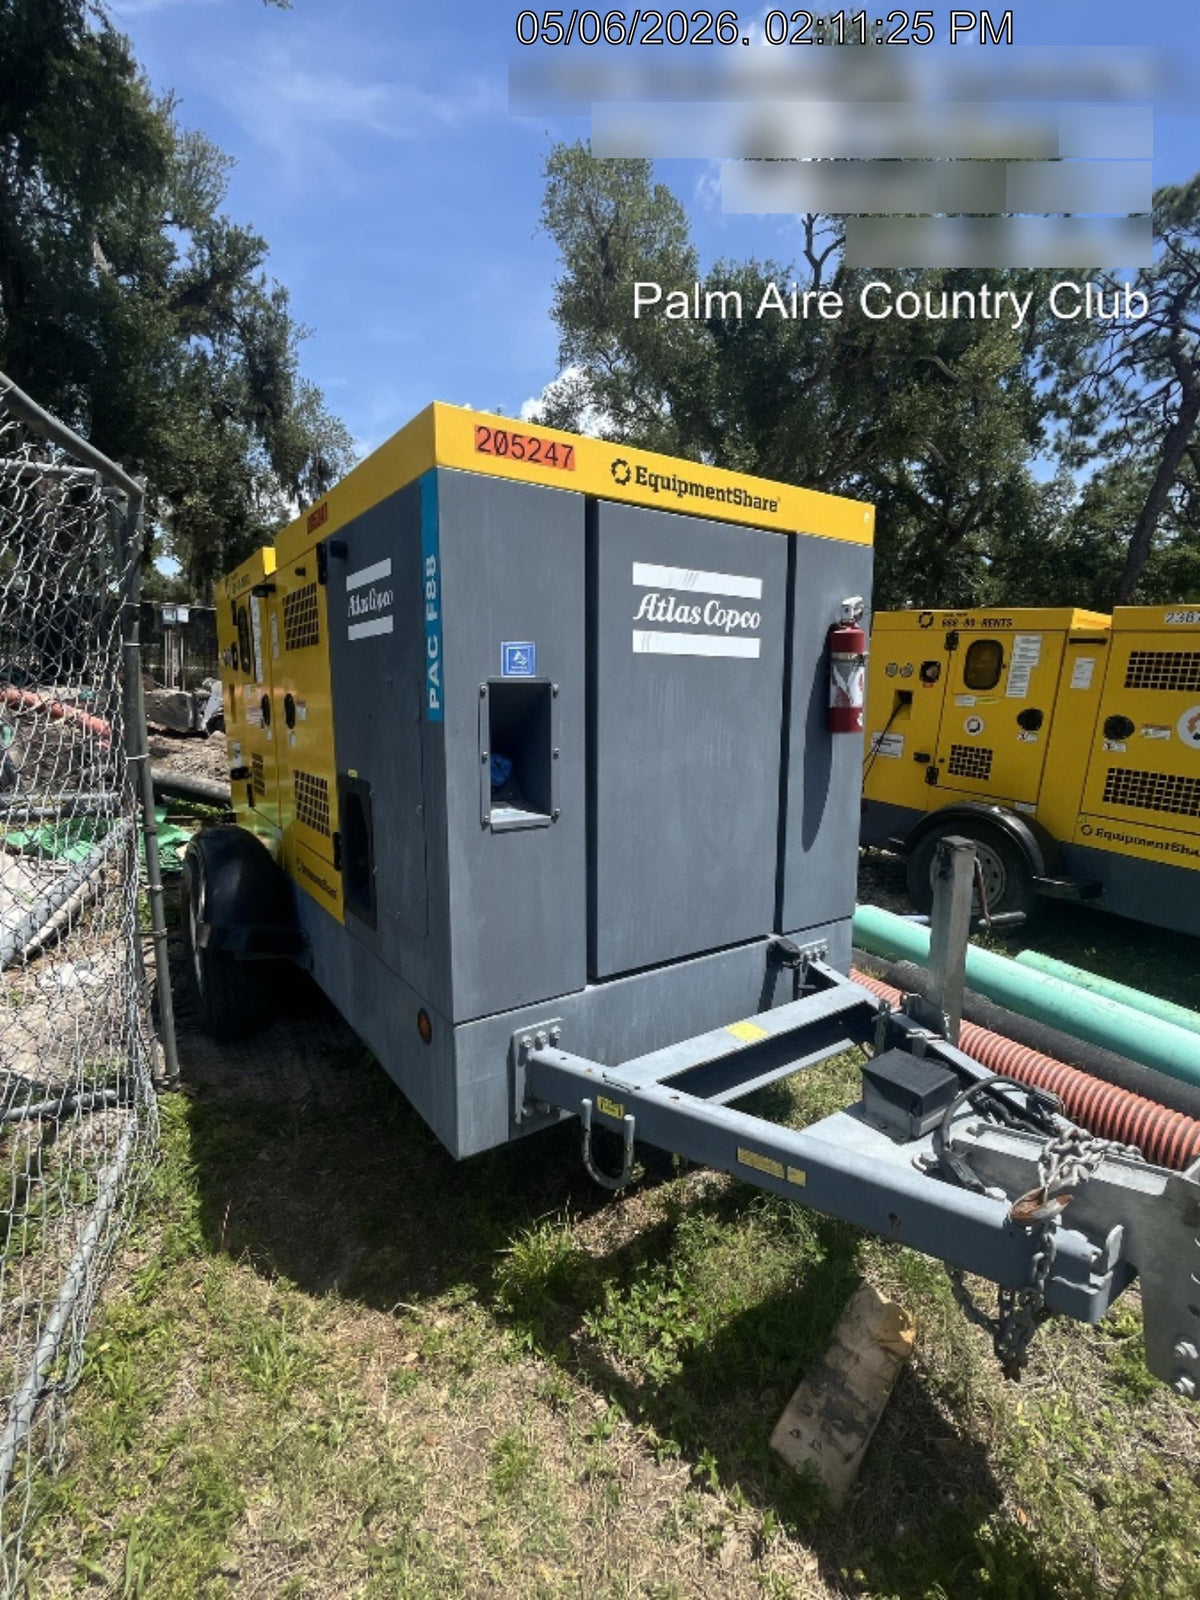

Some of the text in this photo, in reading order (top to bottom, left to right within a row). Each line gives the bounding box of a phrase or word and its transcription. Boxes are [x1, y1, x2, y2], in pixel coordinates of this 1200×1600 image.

[477, 426, 574, 468] 205247
[635, 465, 779, 512] EquipmentShare
[425, 554, 440, 709] PAC F88
[633, 593, 761, 633] Atlas Copco
